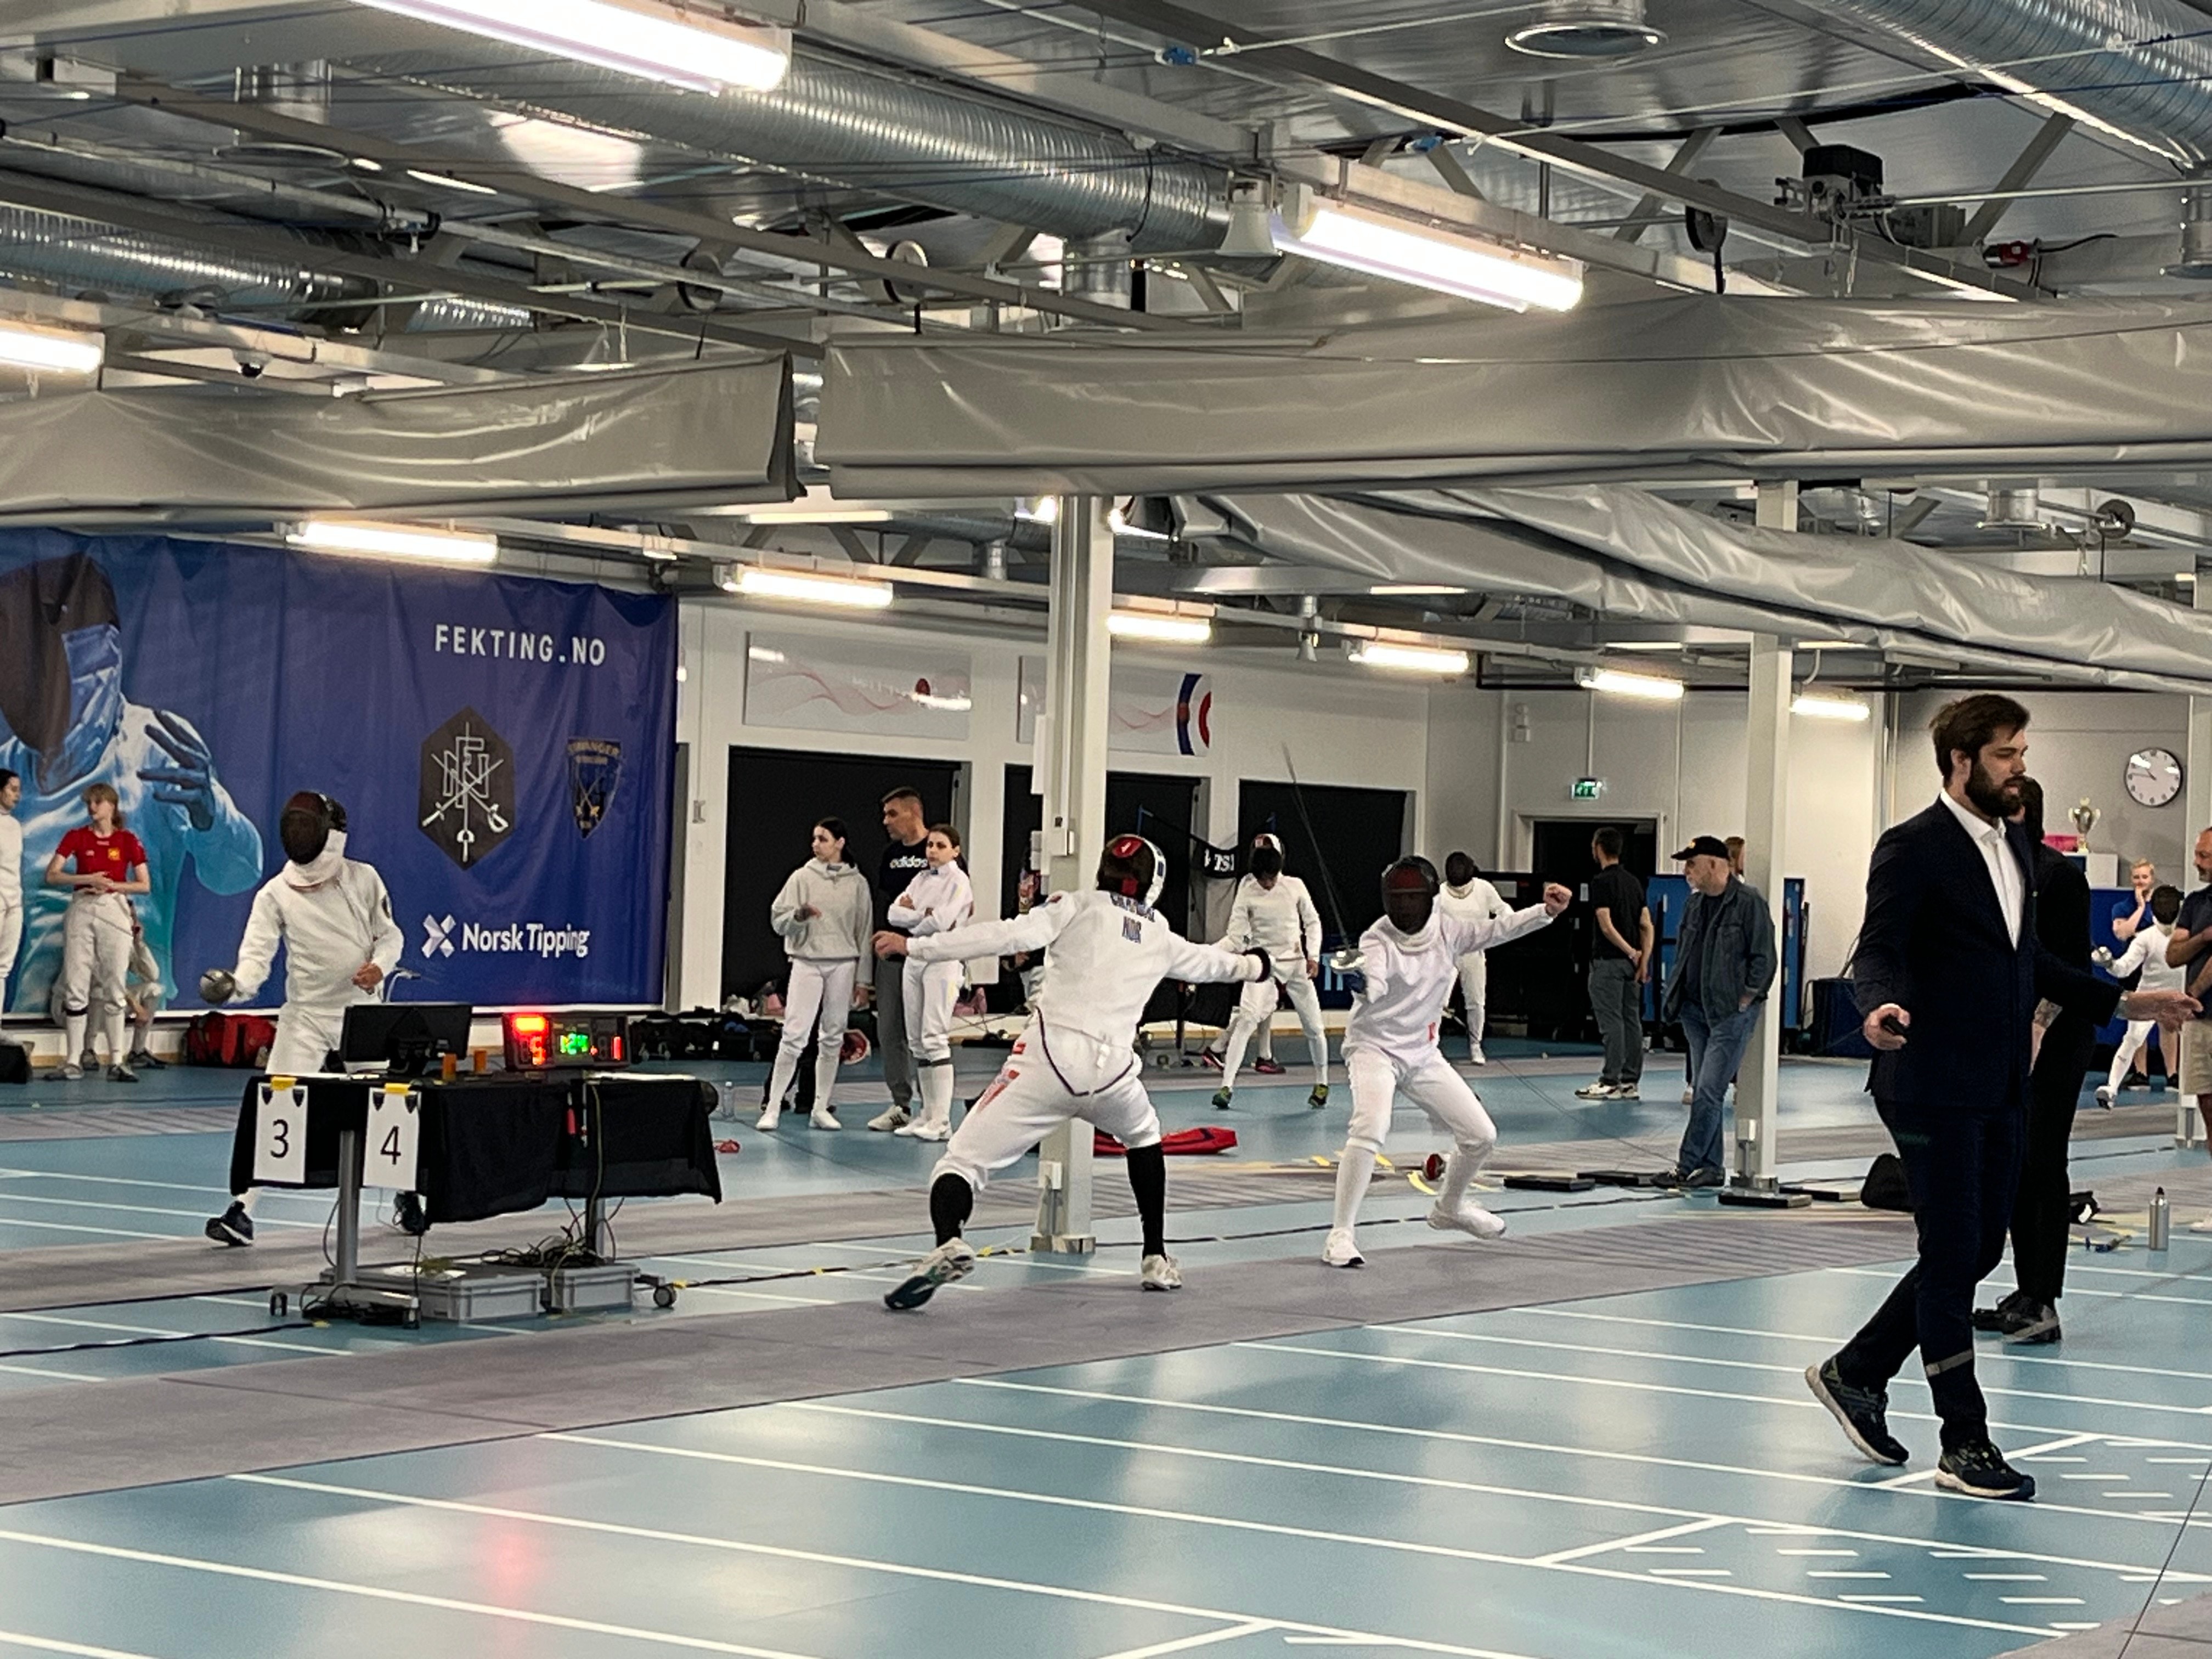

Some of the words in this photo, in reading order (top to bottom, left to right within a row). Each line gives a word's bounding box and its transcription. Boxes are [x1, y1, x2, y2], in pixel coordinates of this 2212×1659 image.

[435, 624, 605, 666] FEKTING.NO
[462, 922, 523, 952] Norsk
[526, 923, 590, 958] Tipping
[270, 1118, 289, 1159] 3
[380, 1125, 402, 1165] 4
